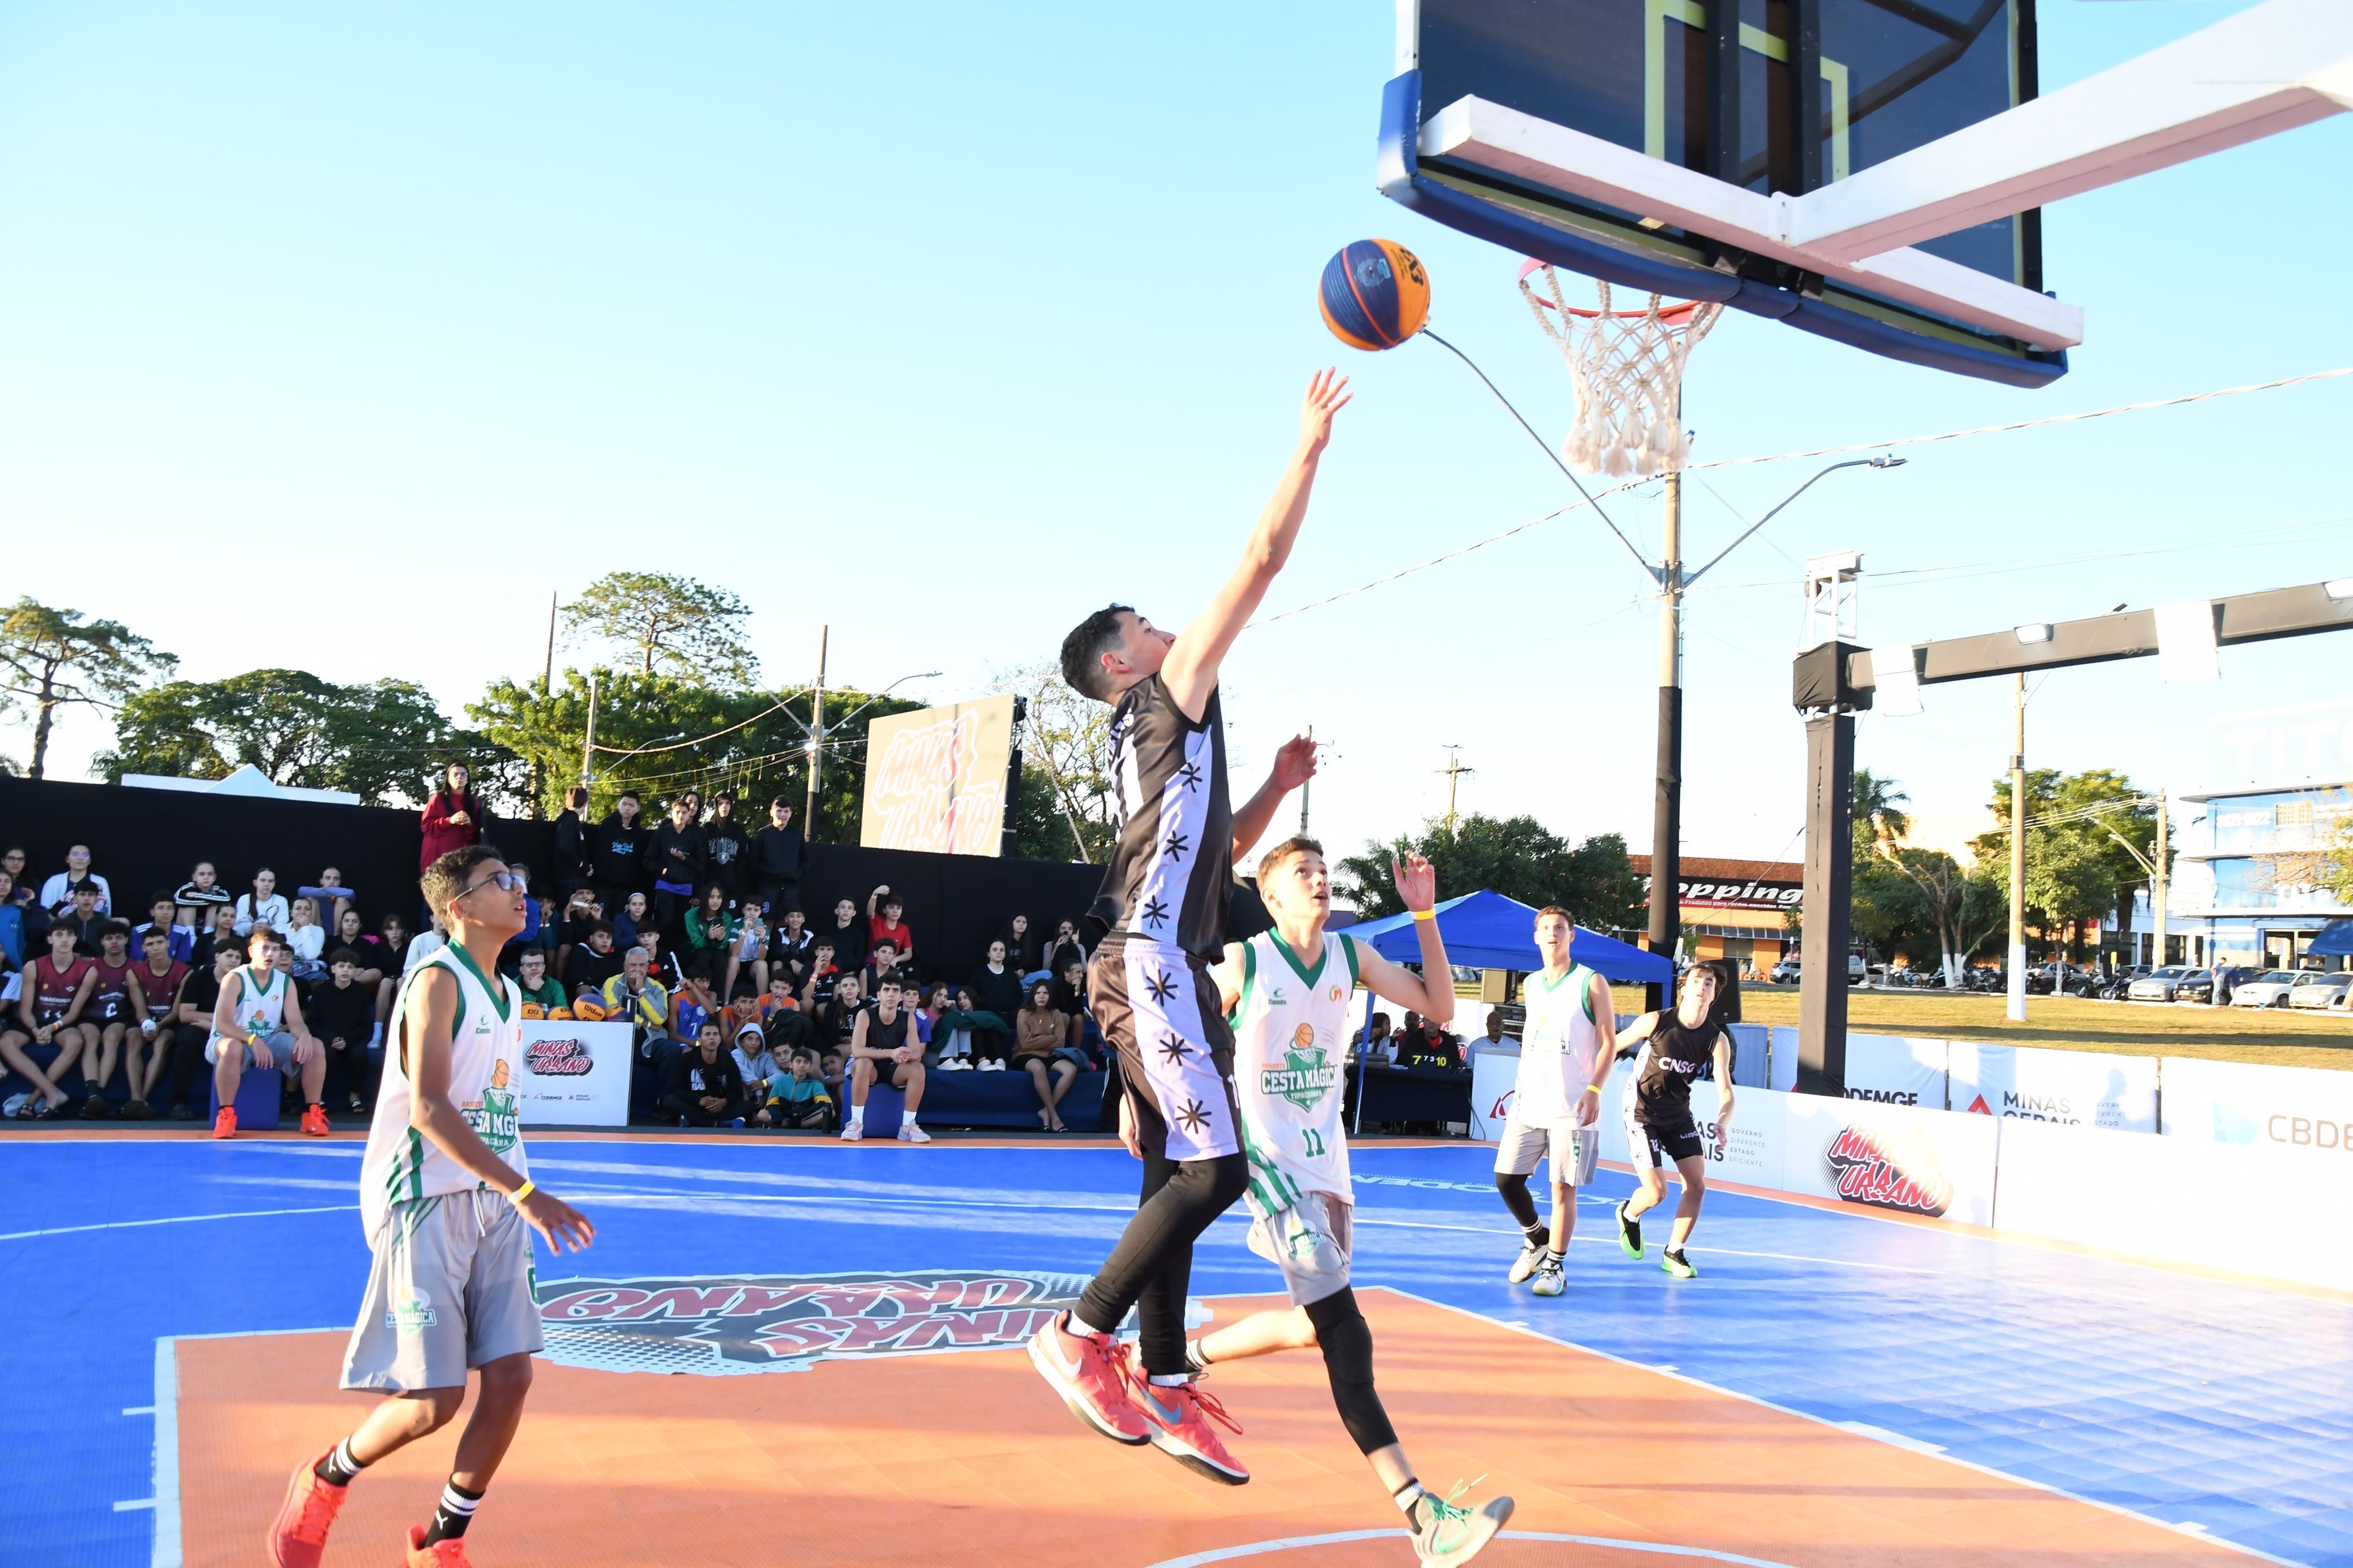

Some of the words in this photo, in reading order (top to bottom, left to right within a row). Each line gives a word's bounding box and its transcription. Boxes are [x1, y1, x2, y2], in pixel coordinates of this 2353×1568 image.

[2222, 718, 2353, 776] TIT
[874, 719, 968, 798] MINAS
[584, 1004, 603, 1017] Wilson
[691, 1022, 697, 1035] 7
[527, 1039, 575, 1056] MINAS
[531, 1055, 591, 1073] URBANO
[1412, 1055, 1422, 1065] 7
[1436, 1056, 1447, 1066] 10
[1261, 1070, 1304, 1094] CESTA
[2004, 1090, 2071, 1114] MINAS
[1731, 1128, 1762, 1138] GOVERNO
[1302, 1128, 1325, 1158] 11
[1730, 1147, 1755, 1156] ESTADO
